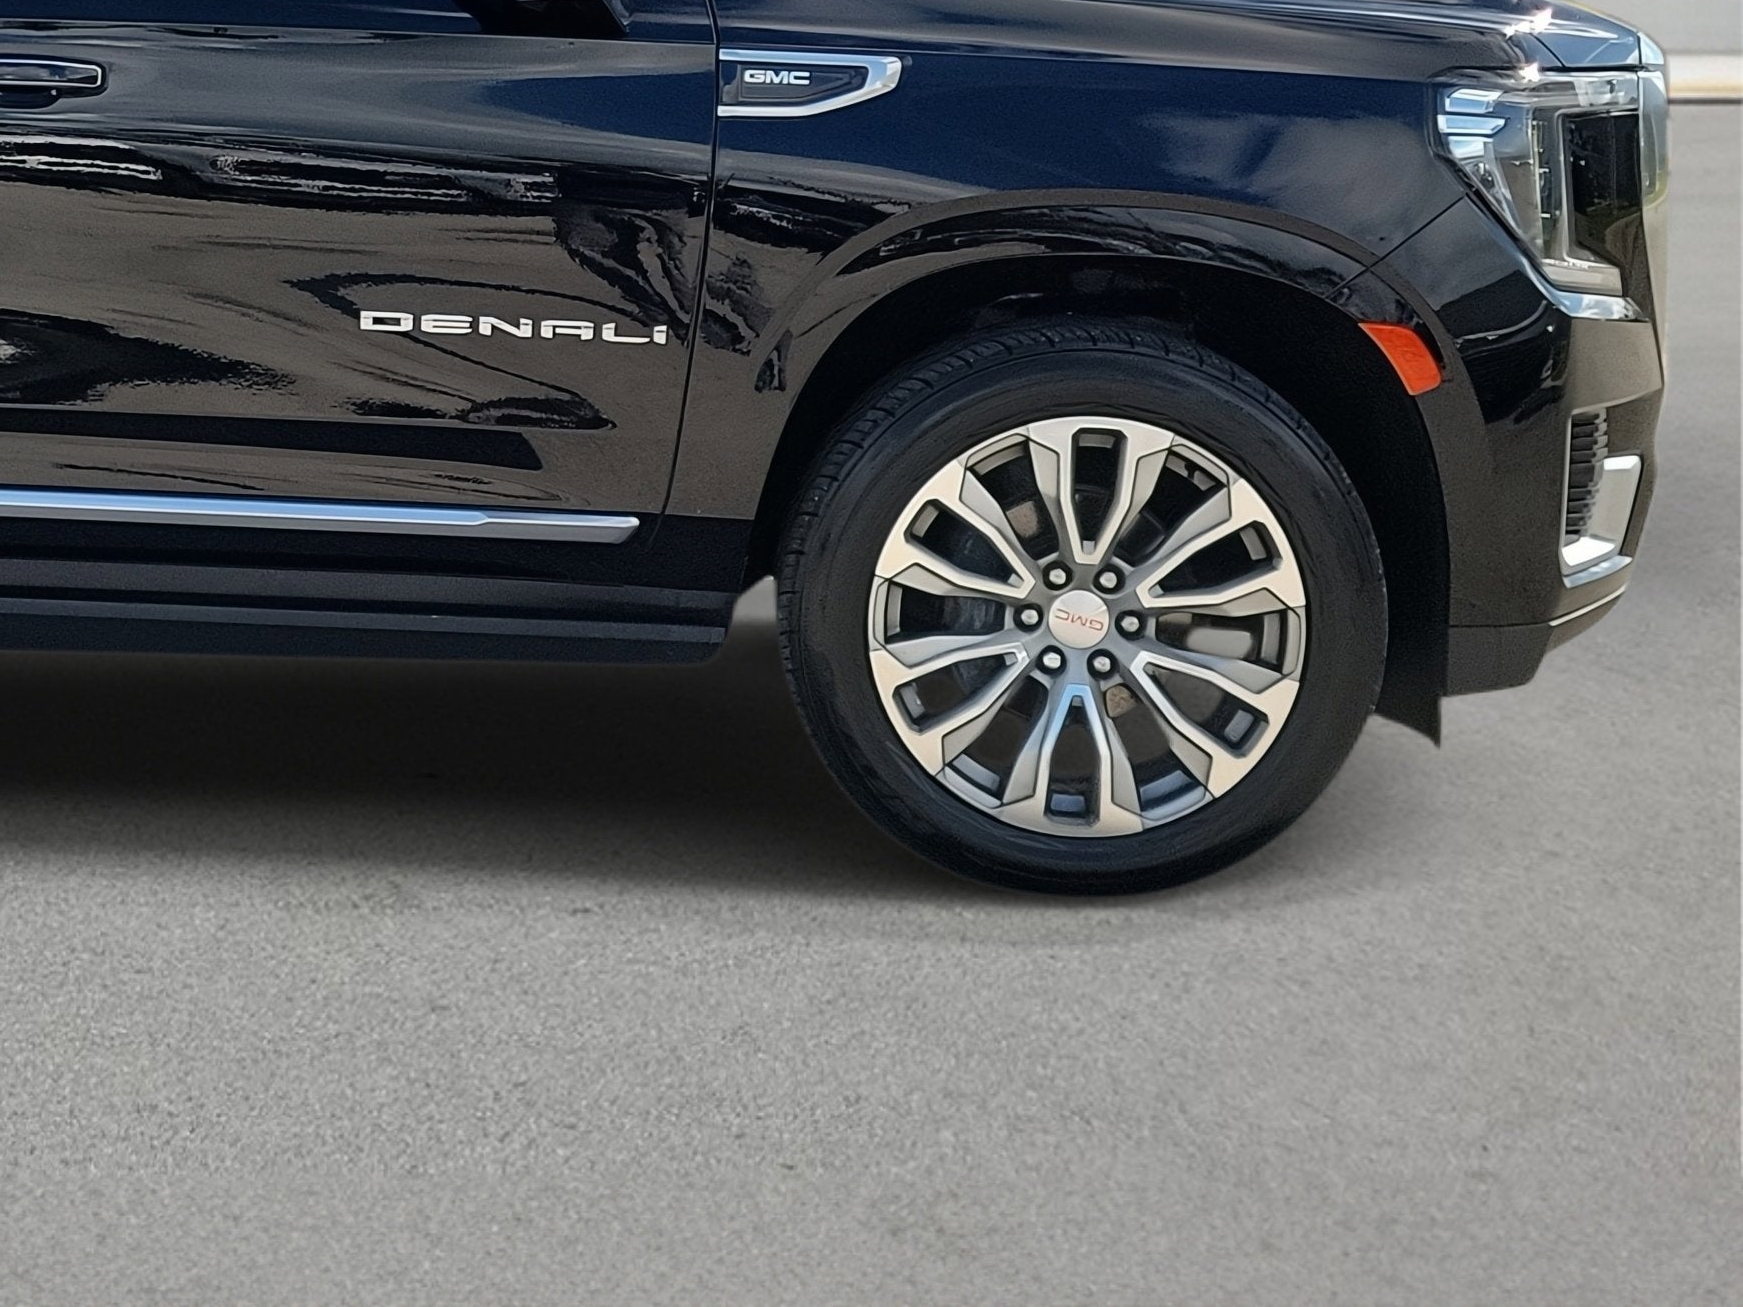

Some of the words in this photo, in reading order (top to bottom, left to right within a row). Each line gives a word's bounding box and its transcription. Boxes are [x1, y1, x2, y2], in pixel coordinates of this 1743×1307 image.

[744, 69, 810, 85] GMC
[359, 310, 668, 345] DENALI
[1055, 608, 1104, 631] GMC
